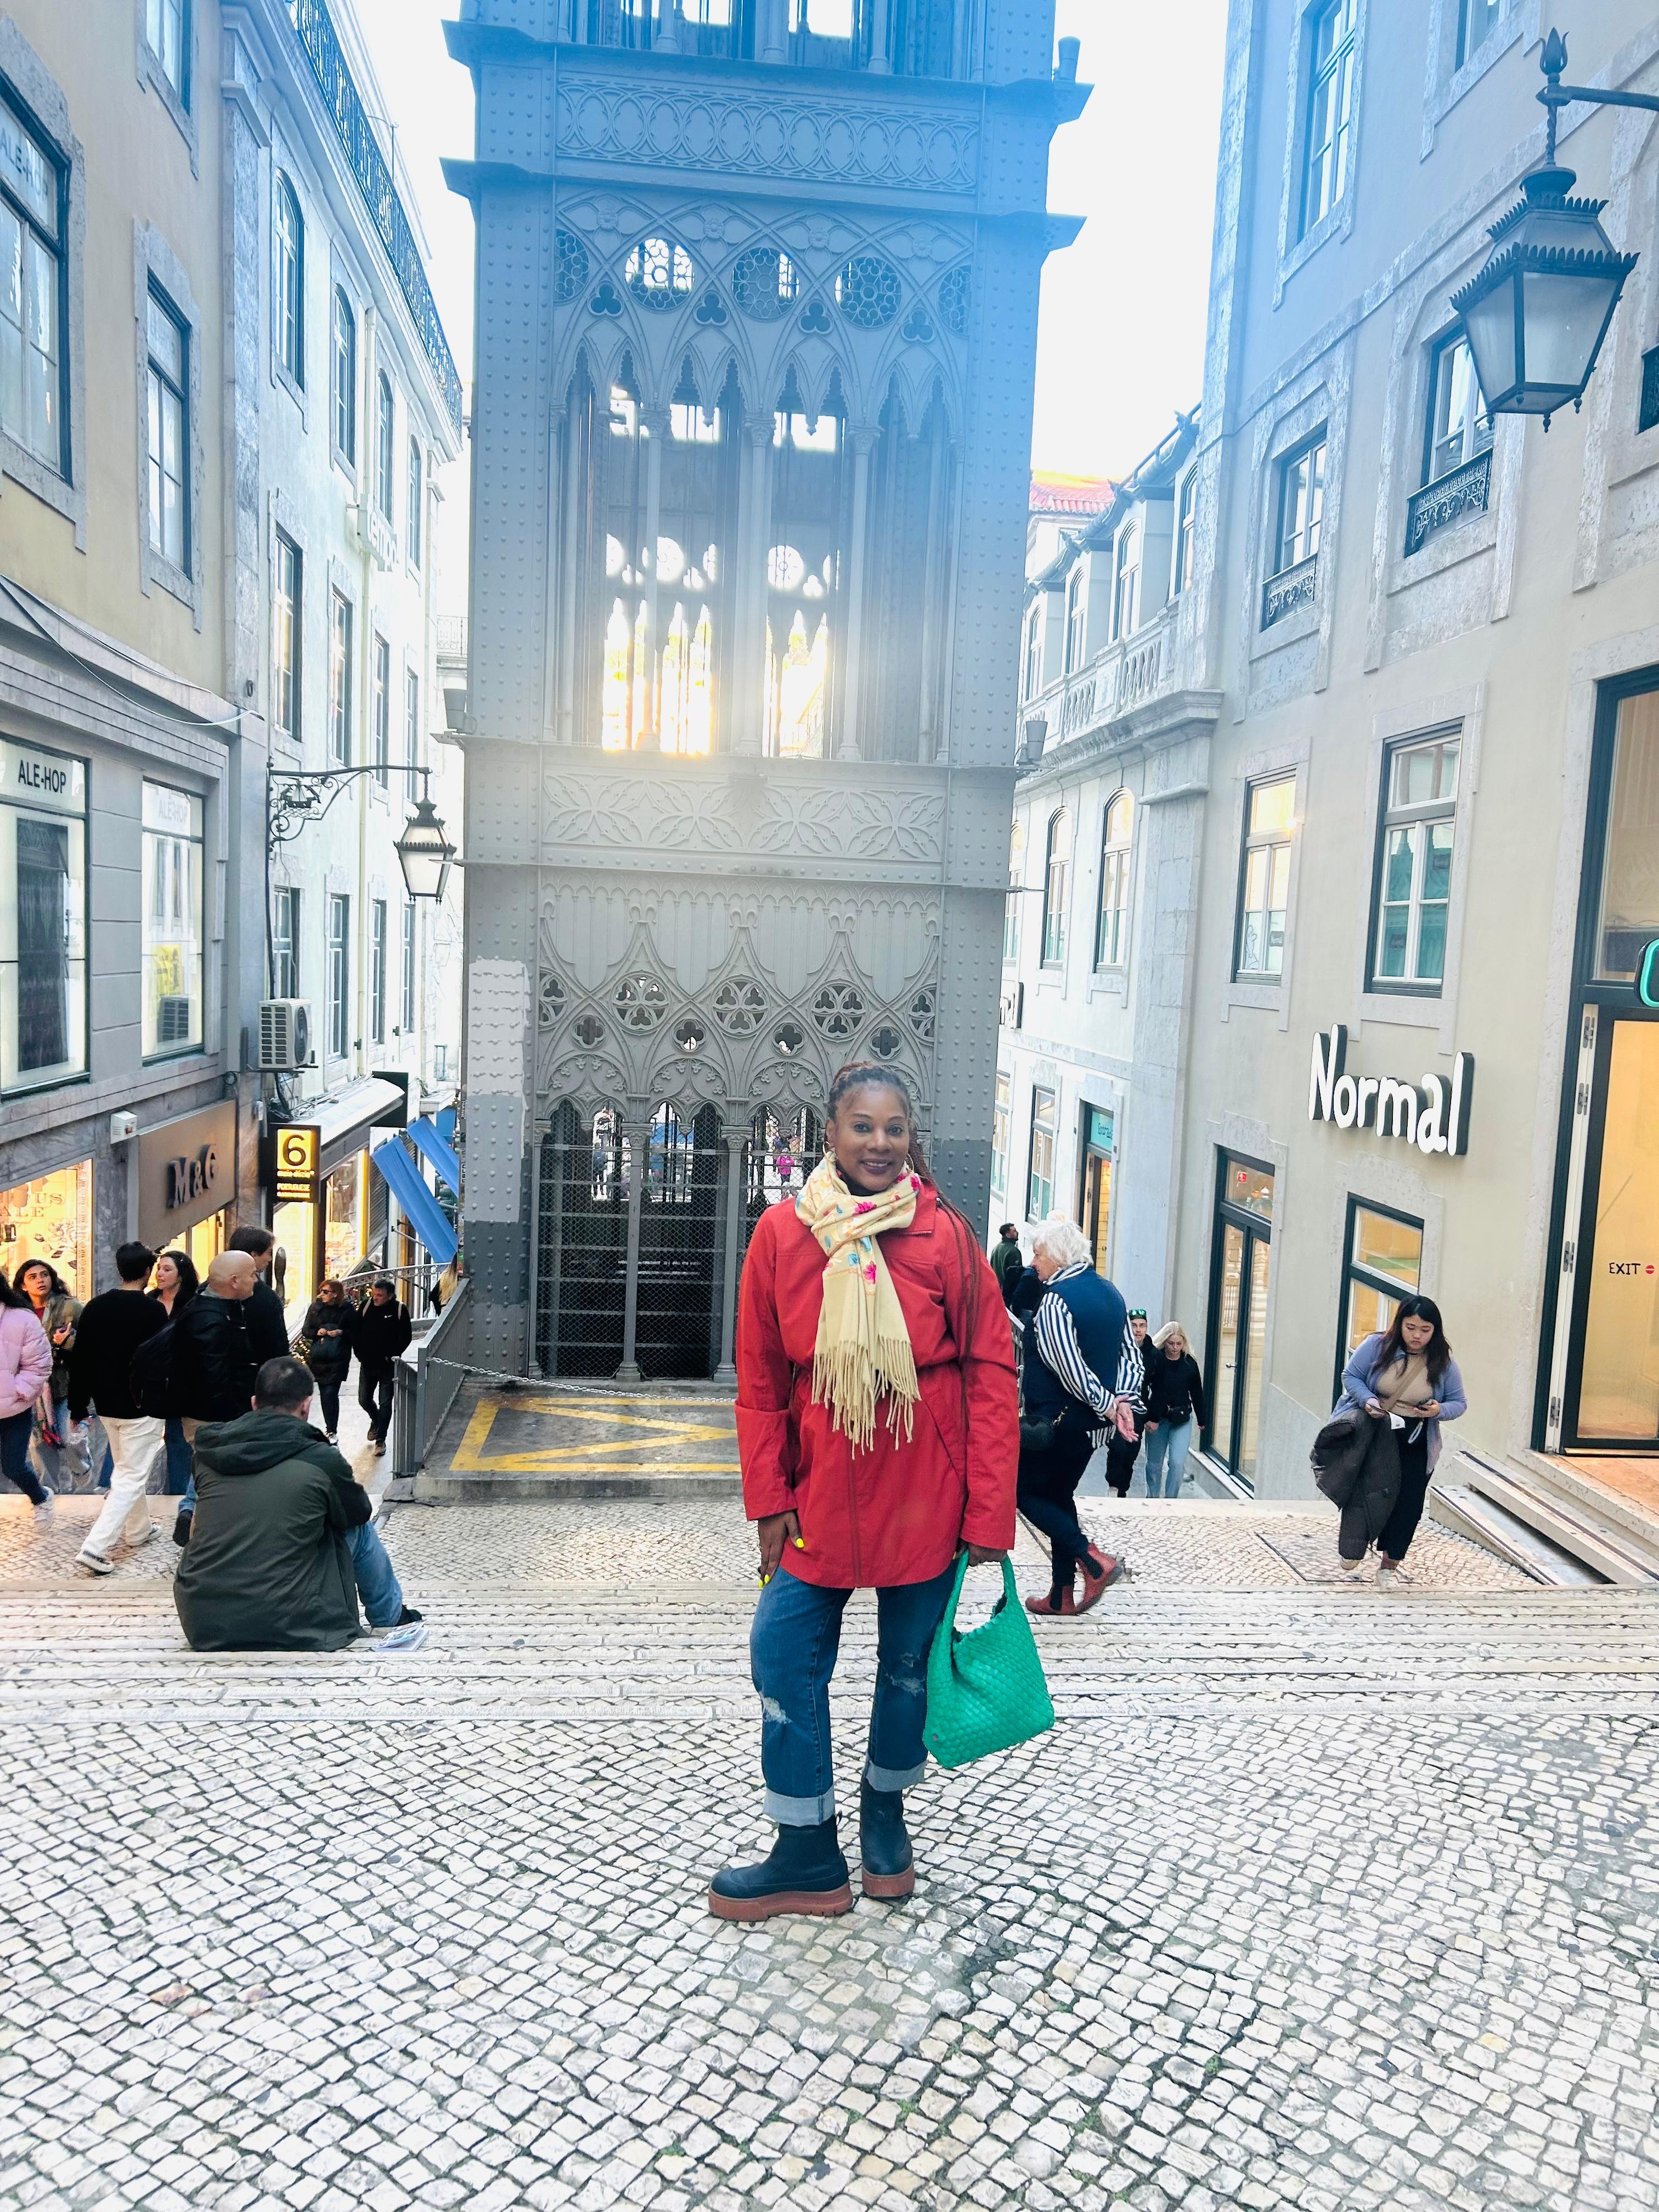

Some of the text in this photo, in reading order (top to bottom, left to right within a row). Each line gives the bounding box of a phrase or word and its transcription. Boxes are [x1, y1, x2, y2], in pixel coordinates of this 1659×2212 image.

[18, 759, 66, 794] ALE-HOP
[1308, 1023, 1474, 1156] Normal
[283, 1135, 306, 1166] 6
[1609, 1262, 1641, 1275] EXIT
